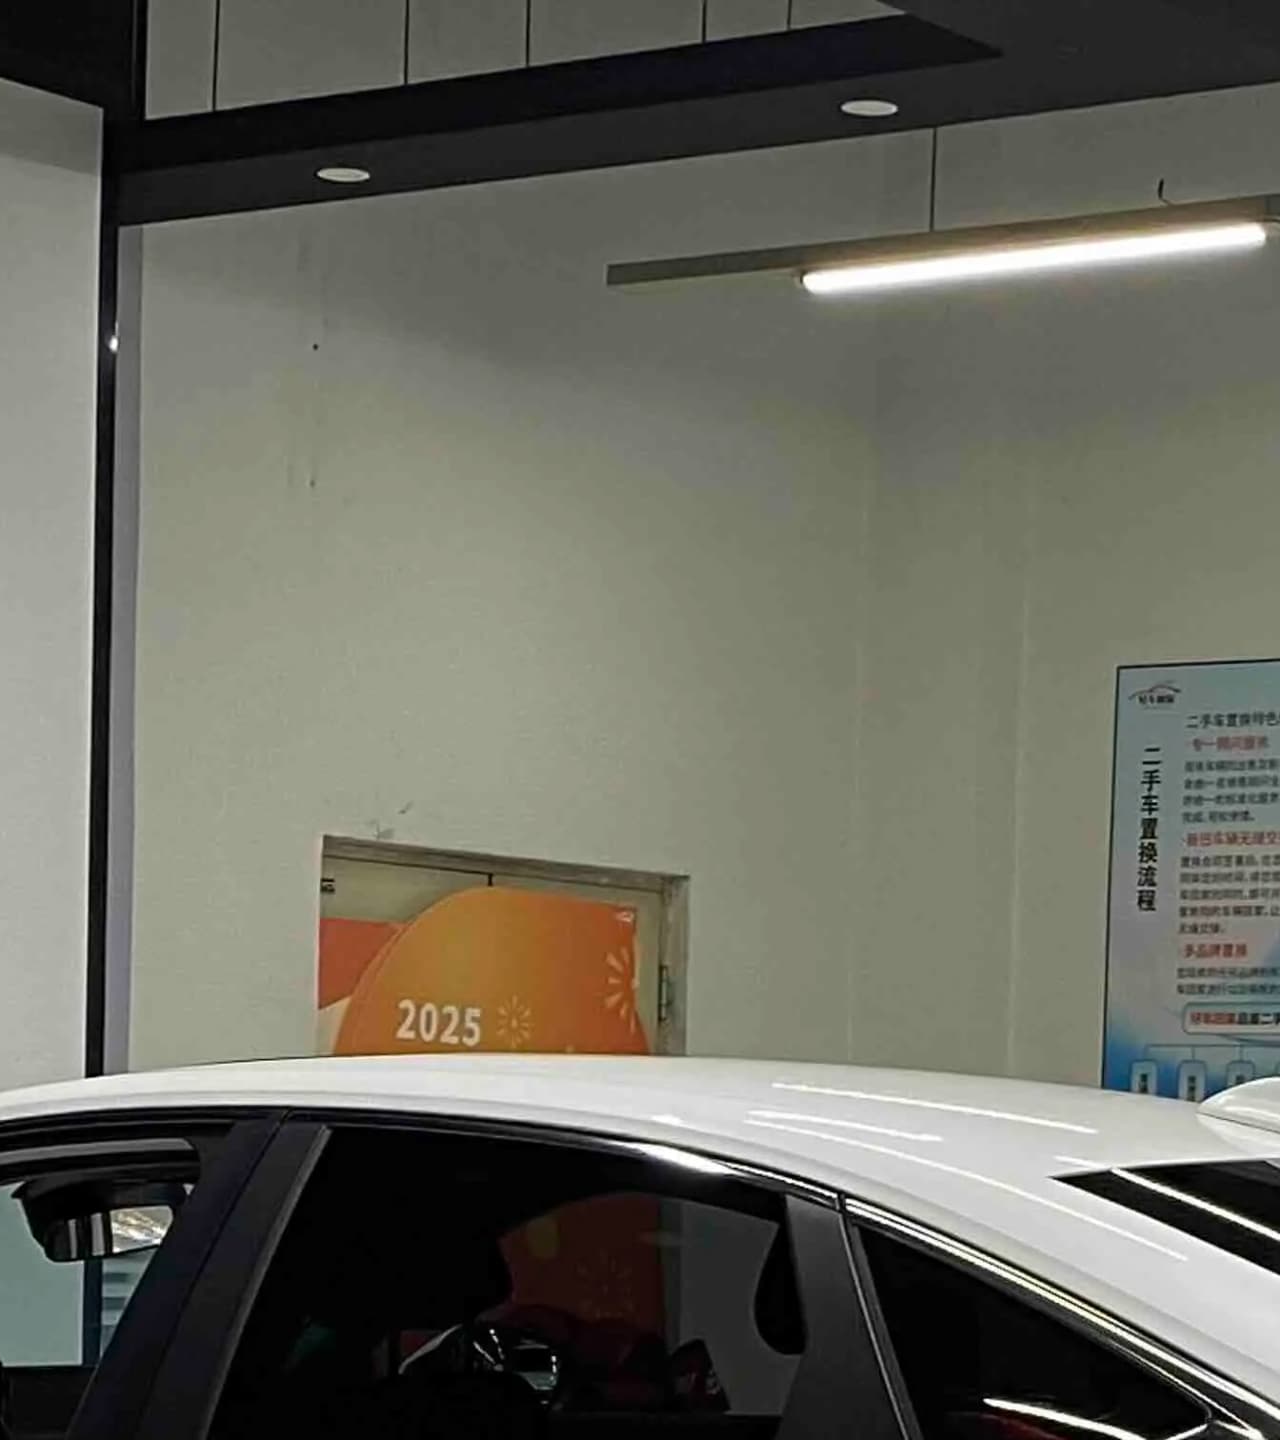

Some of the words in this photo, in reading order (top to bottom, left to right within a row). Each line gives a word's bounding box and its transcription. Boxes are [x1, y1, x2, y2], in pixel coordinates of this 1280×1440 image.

[1136, 747, 1162, 912] 二手车置换流程
[395, 998, 483, 1047] 2025
